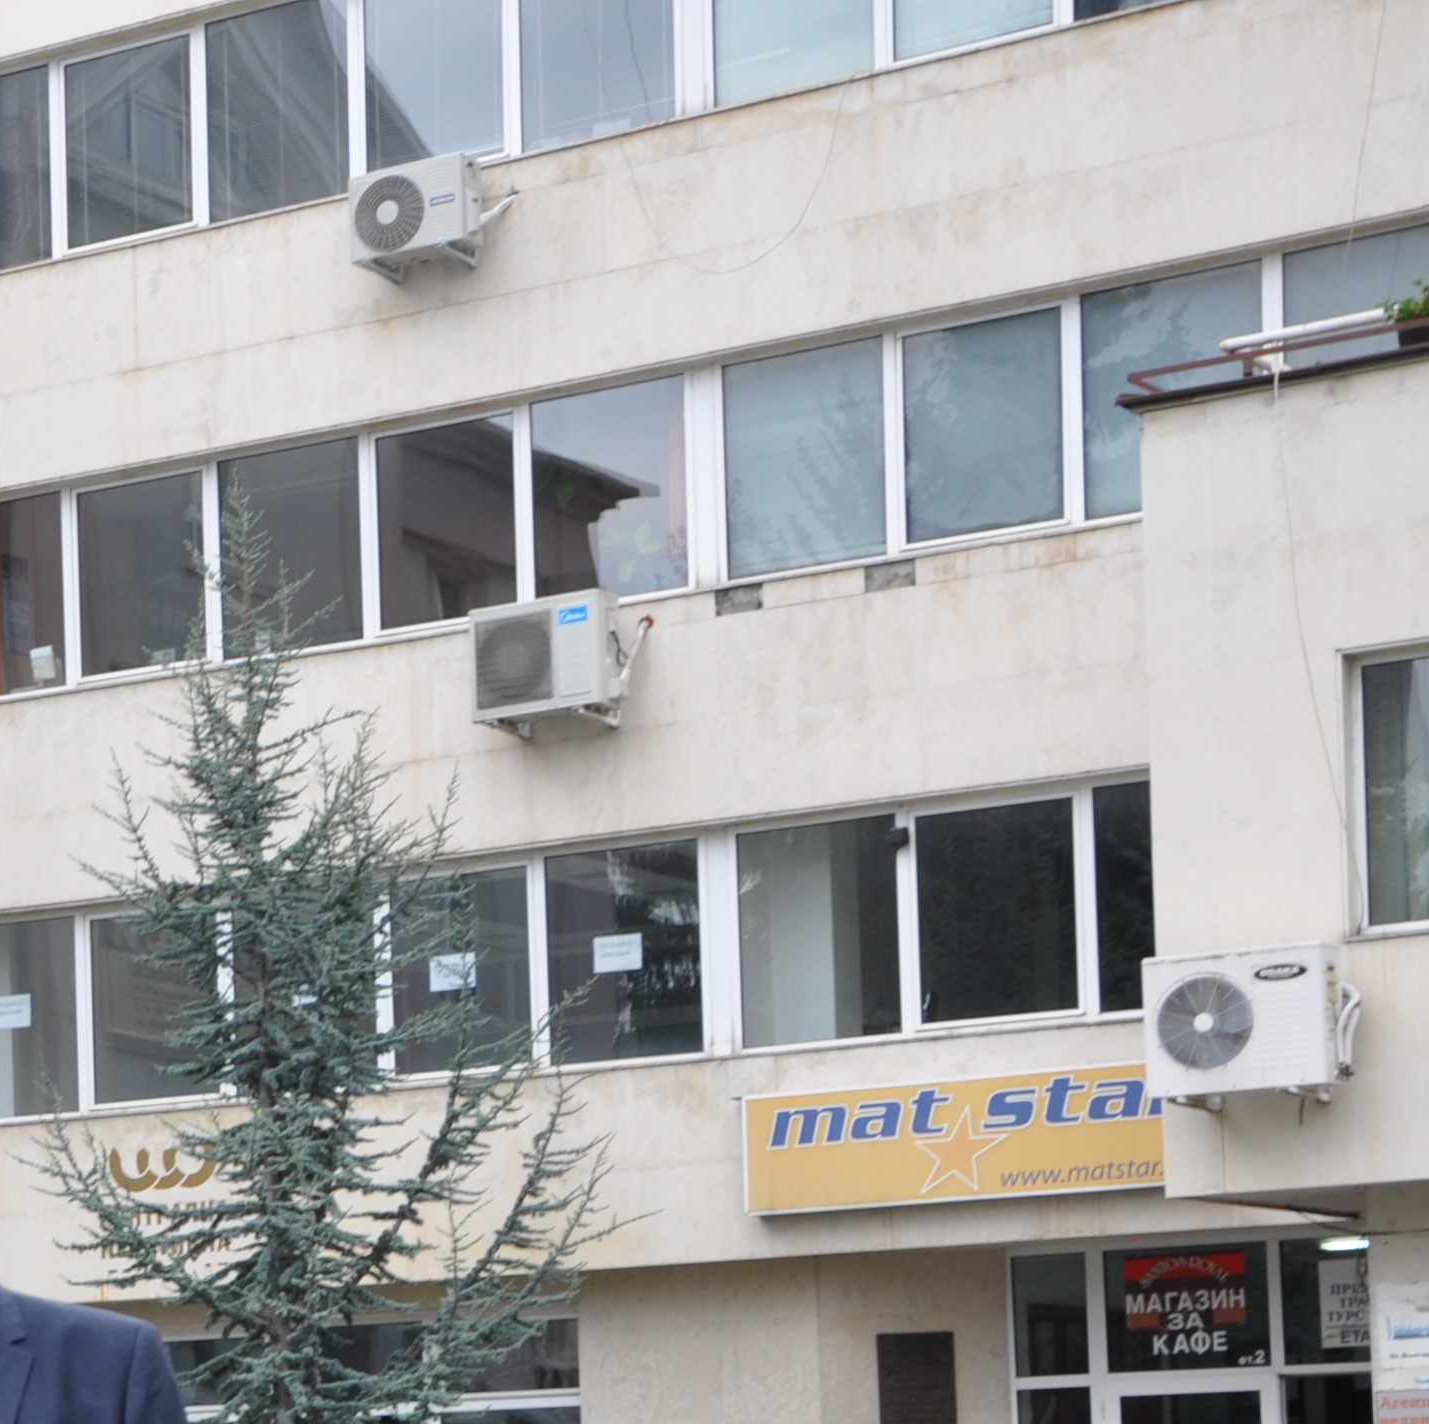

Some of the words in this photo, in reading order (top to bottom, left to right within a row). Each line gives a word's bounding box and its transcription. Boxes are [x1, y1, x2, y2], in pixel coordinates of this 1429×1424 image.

[767, 1087, 951, 1151] mat
[1125, 1287, 1246, 1315] МАГАЗИН
[1167, 1311, 1204, 1331] ЗА
[1152, 1328, 1229, 1356] КАФЕ
